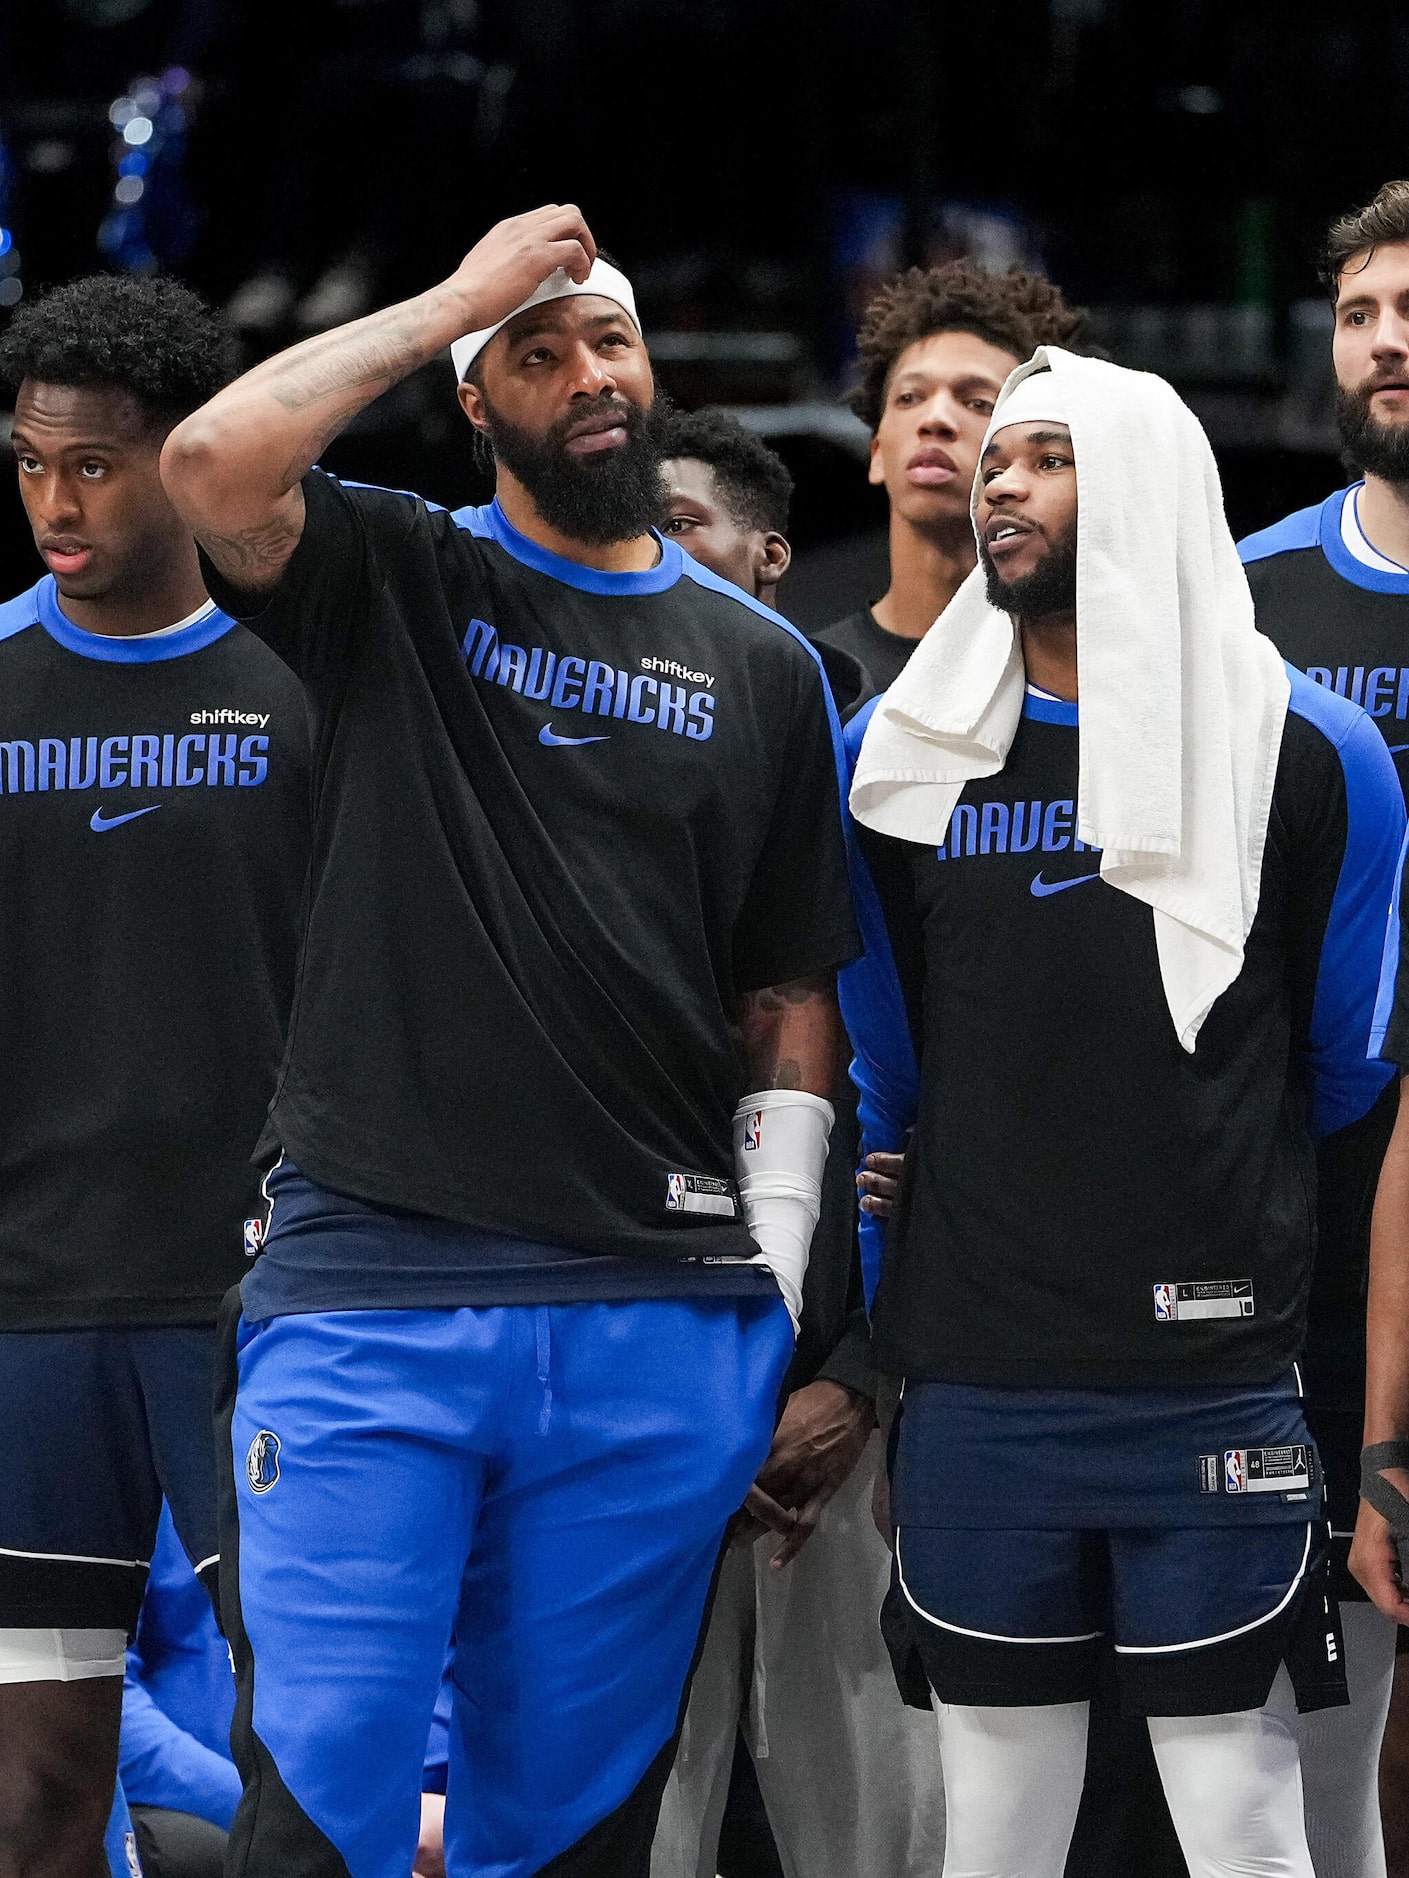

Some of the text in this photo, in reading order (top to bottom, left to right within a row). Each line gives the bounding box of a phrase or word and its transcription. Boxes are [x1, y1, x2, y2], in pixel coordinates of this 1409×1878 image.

[459, 618, 716, 742] MAVERICKS
[640, 656, 715, 688] shiftkey
[190, 709, 270, 728] shiftkey
[1250, 1460, 1260, 1469] 48
